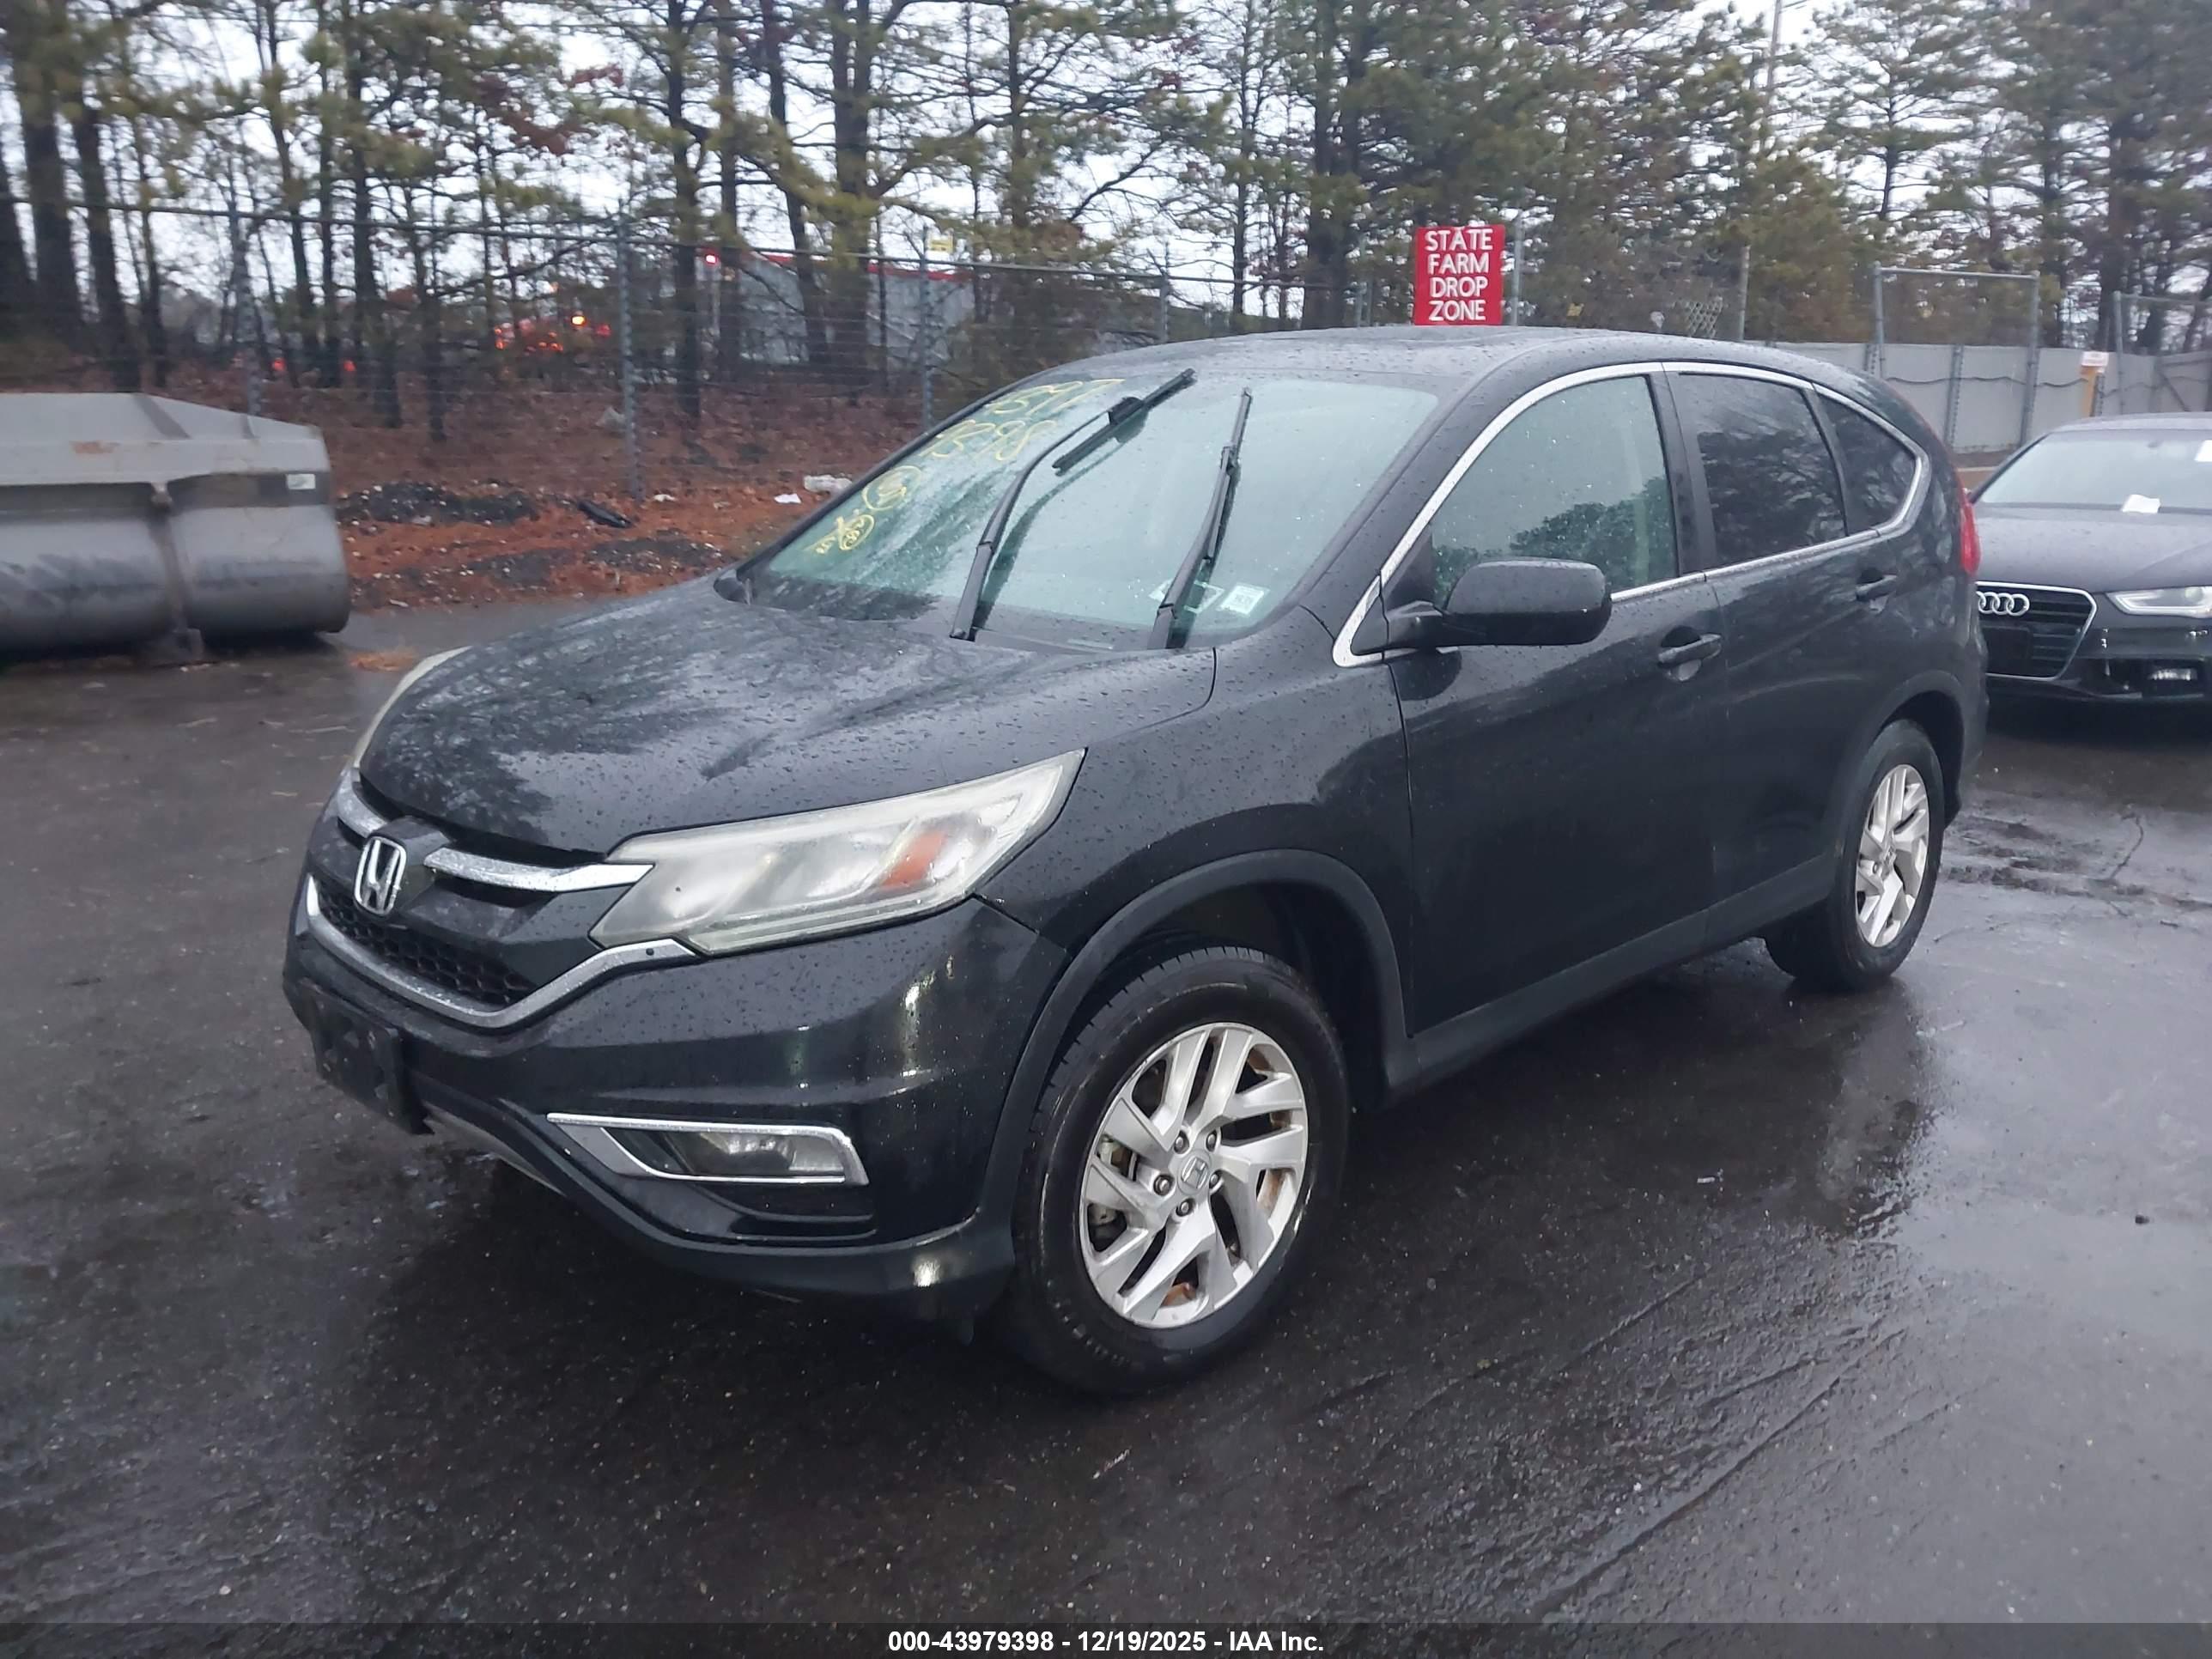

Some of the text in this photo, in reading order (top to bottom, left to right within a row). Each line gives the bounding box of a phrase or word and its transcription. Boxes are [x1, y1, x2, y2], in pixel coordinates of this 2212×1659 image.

[1425, 228, 1493, 251] STATE
[1427, 252, 1489, 274] FARM
[1430, 276, 1488, 298] DROP
[1429, 300, 1486, 321] ZONE
